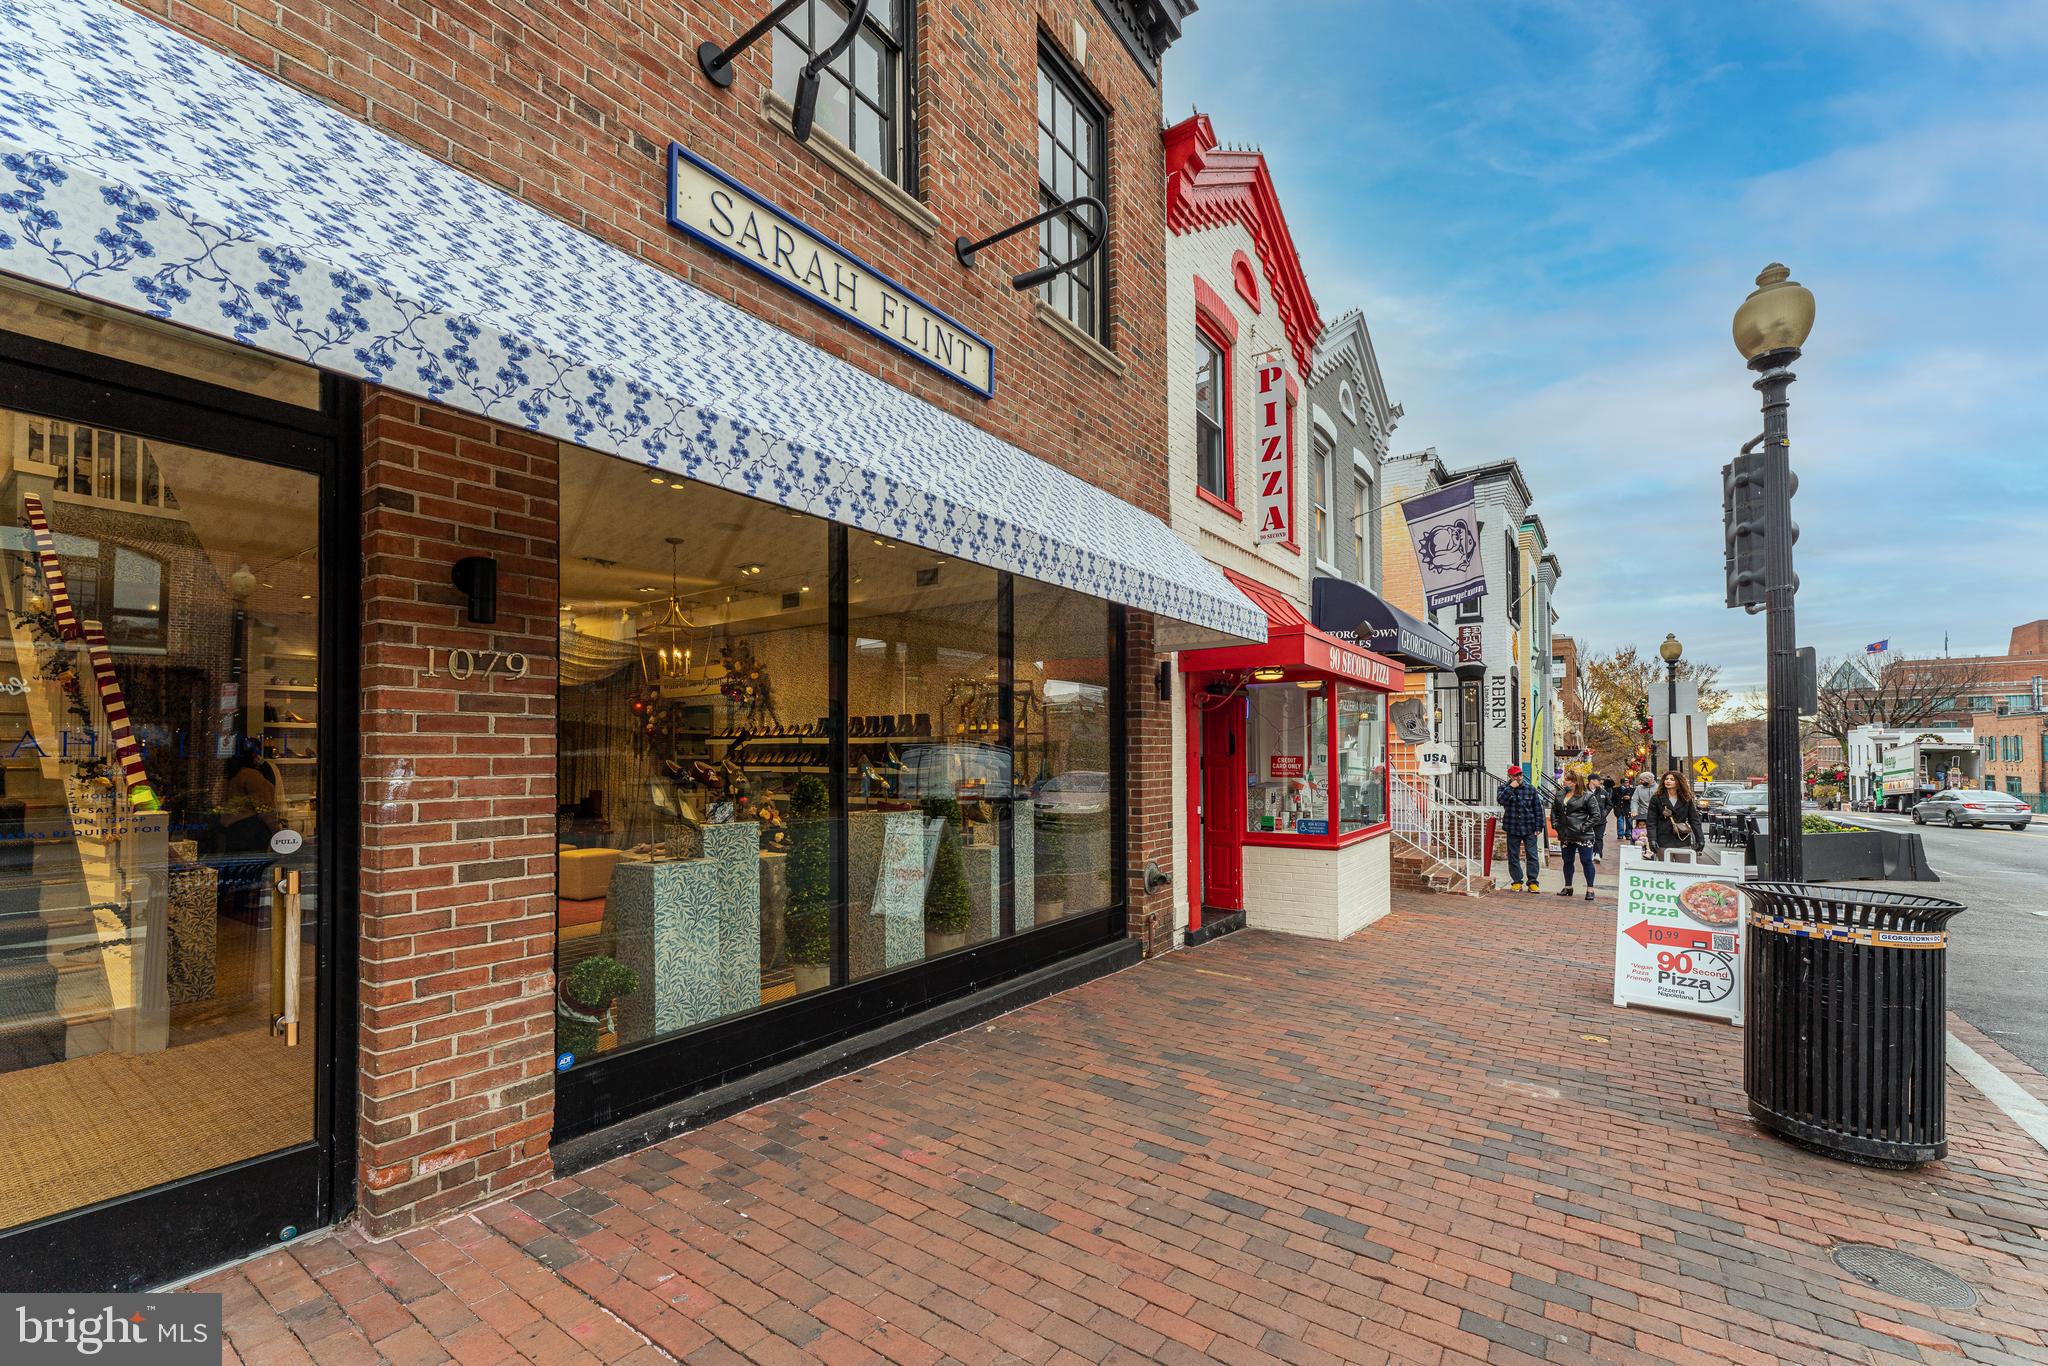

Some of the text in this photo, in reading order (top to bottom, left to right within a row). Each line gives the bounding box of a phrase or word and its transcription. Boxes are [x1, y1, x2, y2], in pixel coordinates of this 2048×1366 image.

[709, 190, 973, 375] SARAH FLINT
[1258, 366, 1286, 532] PIZZA
[1430, 584, 1484, 607] Georgetown
[1401, 629, 1441, 662] GEORGETOWN
[1441, 647, 1454, 667] TEES
[421, 645, 530, 681] 1079
[1329, 646, 1390, 685] 90 SECOND PIZZA
[1492, 675, 1507, 729] REREN
[0, 730, 99, 758] AH
[1423, 753, 1448, 764] USA
[1629, 875, 1676, 891] Brick
[1629, 889, 1679, 904] Oven
[1628, 901, 1679, 918] Pizza
[1881, 934, 1930, 942] GEORGETOWN
[1656, 951, 1693, 974] 90
[1626, 974, 1653, 984] Friendly
[1658, 971, 1711, 990] Pizza
[1692, 967, 1728, 979] Second
[1657, 986, 1685, 995] Pizzeria
[1657, 991, 1694, 1001] Napoletana
[559, 1055, 572, 1066] ADT
